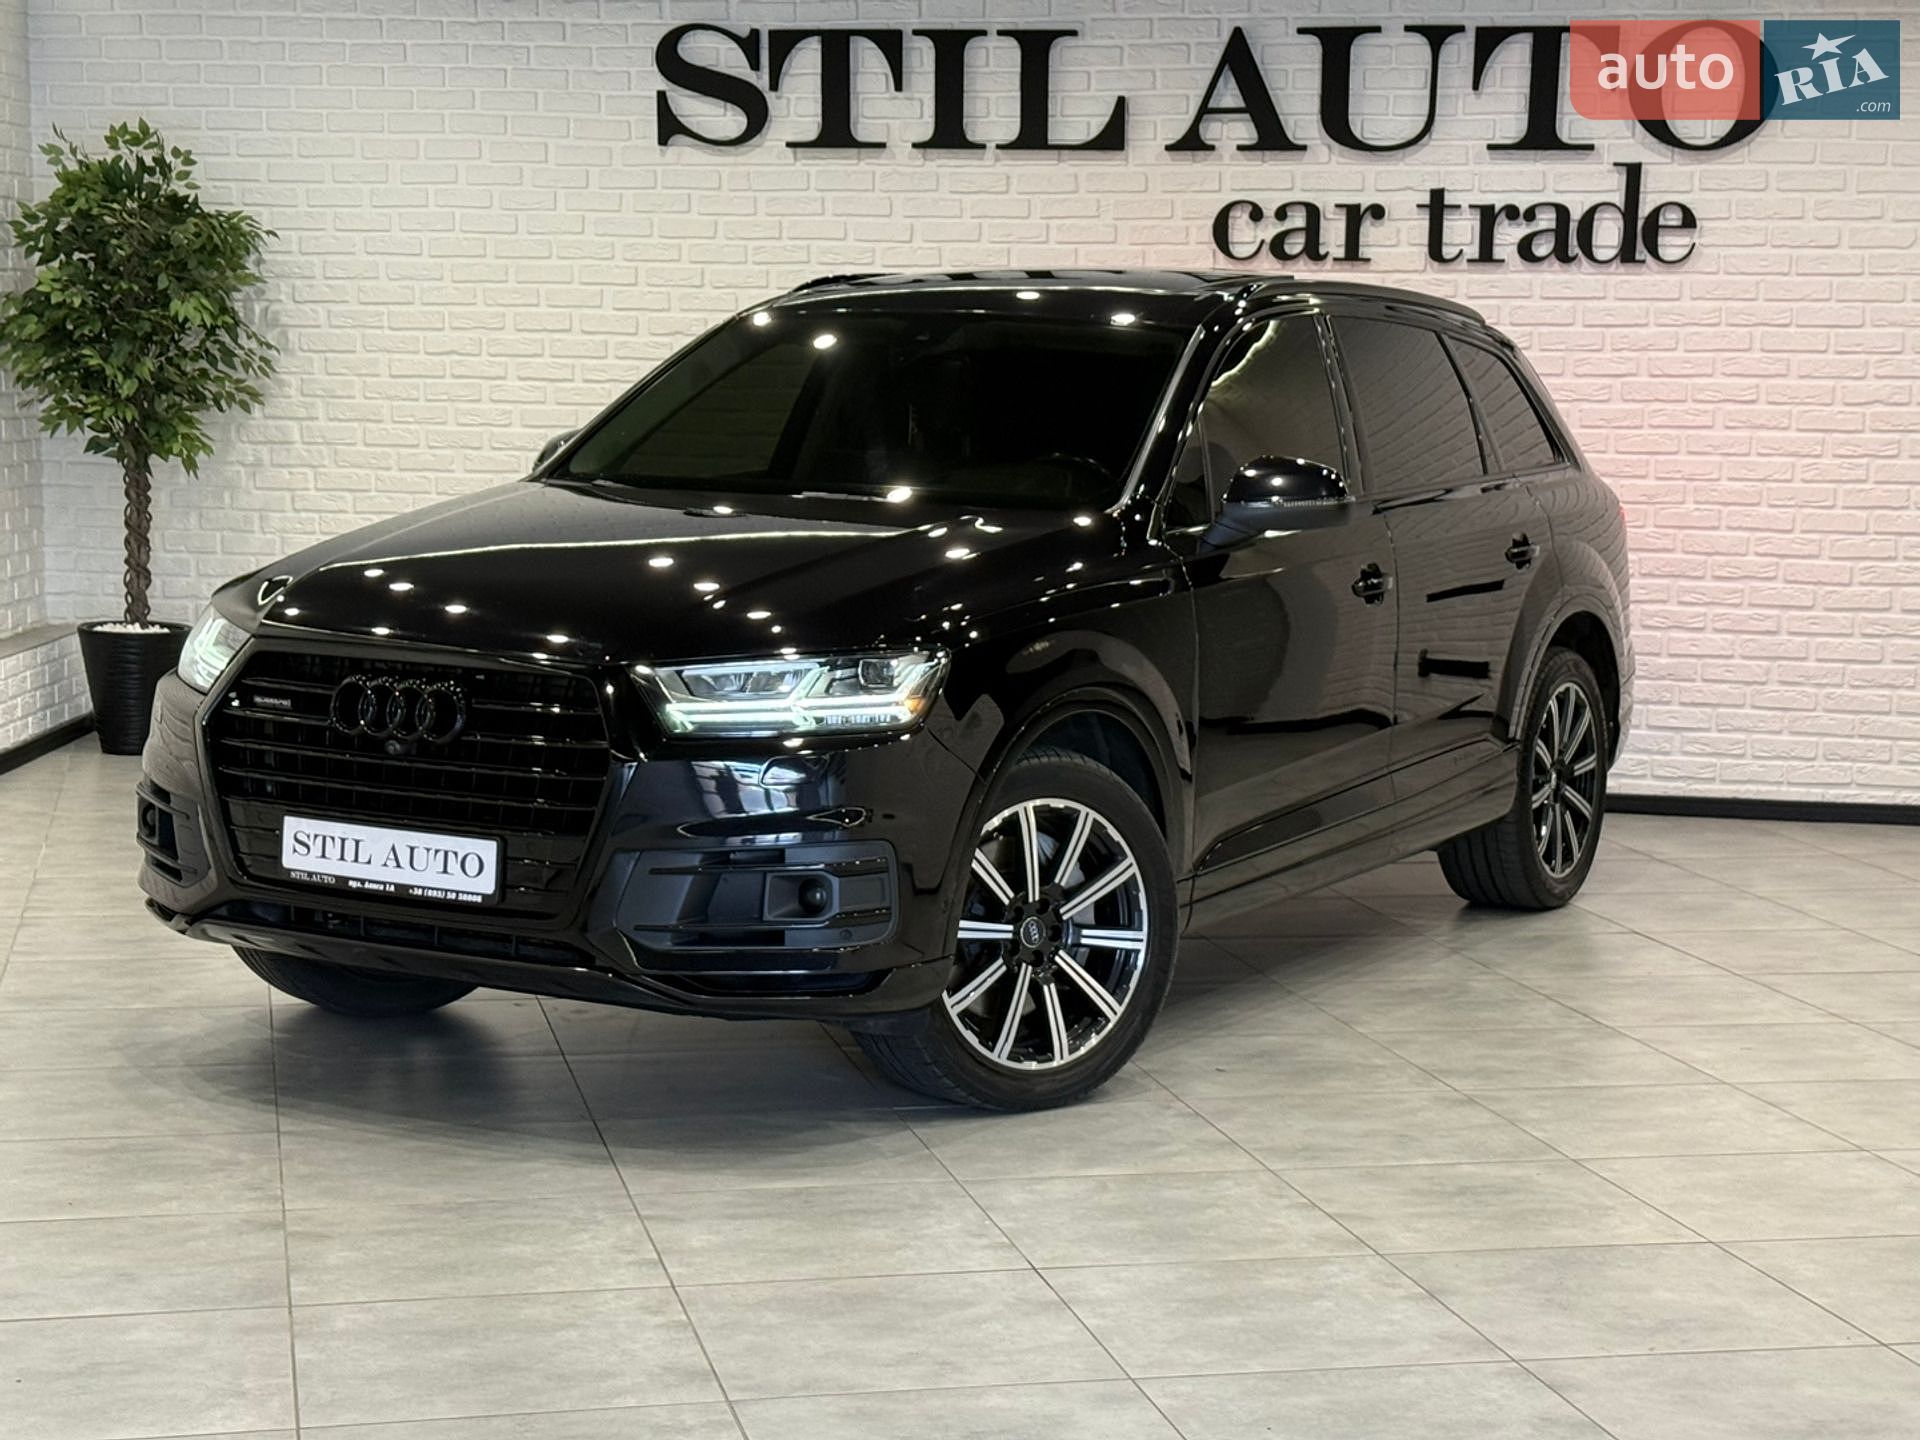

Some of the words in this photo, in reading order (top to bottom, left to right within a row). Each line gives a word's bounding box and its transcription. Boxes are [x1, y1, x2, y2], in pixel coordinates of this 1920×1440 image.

[655, 22, 1126, 151] STIL
[1165, 20, 1779, 152] AUTO
[1212, 200, 1386, 263] car
[1416, 161, 1698, 265] trade
[290, 871, 310, 881] STIL
[311, 874, 336, 884] AUTO
[292, 830, 373, 865] STIL
[382, 842, 485, 878] AUTO
